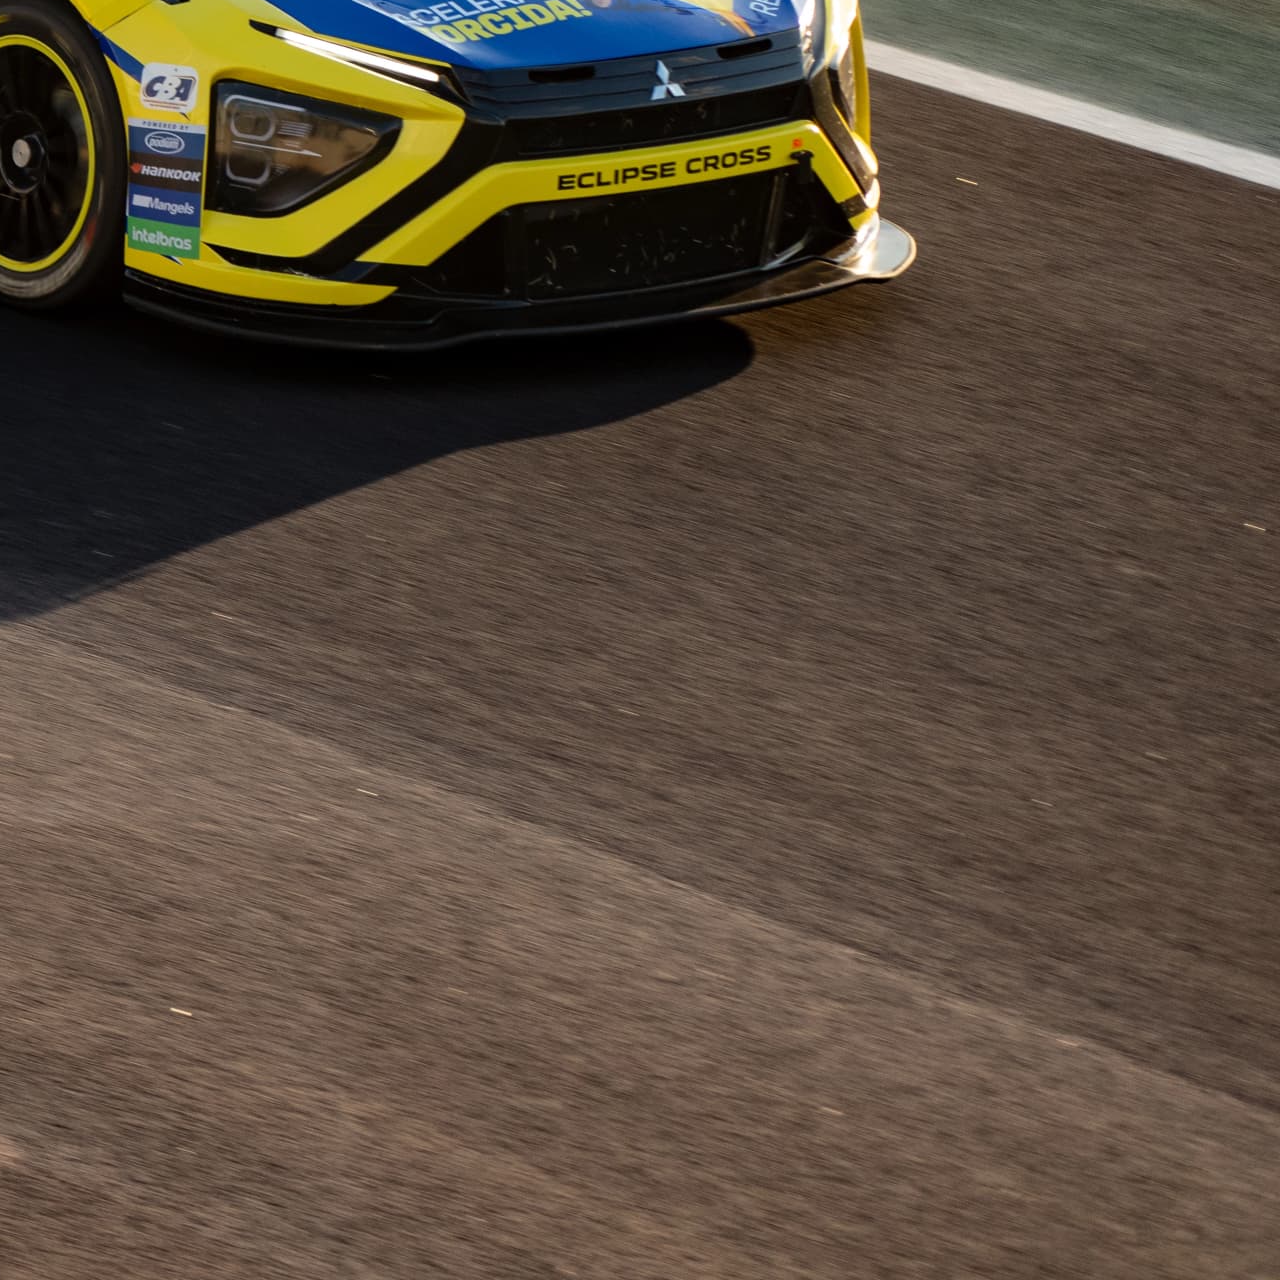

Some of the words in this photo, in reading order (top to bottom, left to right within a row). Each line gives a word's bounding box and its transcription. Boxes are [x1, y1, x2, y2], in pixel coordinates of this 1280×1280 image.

[145, 75, 193, 102] CBA
[142, 120, 178, 130] POWERED
[557, 161, 677, 191] ECLIPSE
[685, 145, 772, 175] CROSS
[132, 225, 193, 251] intelbras
